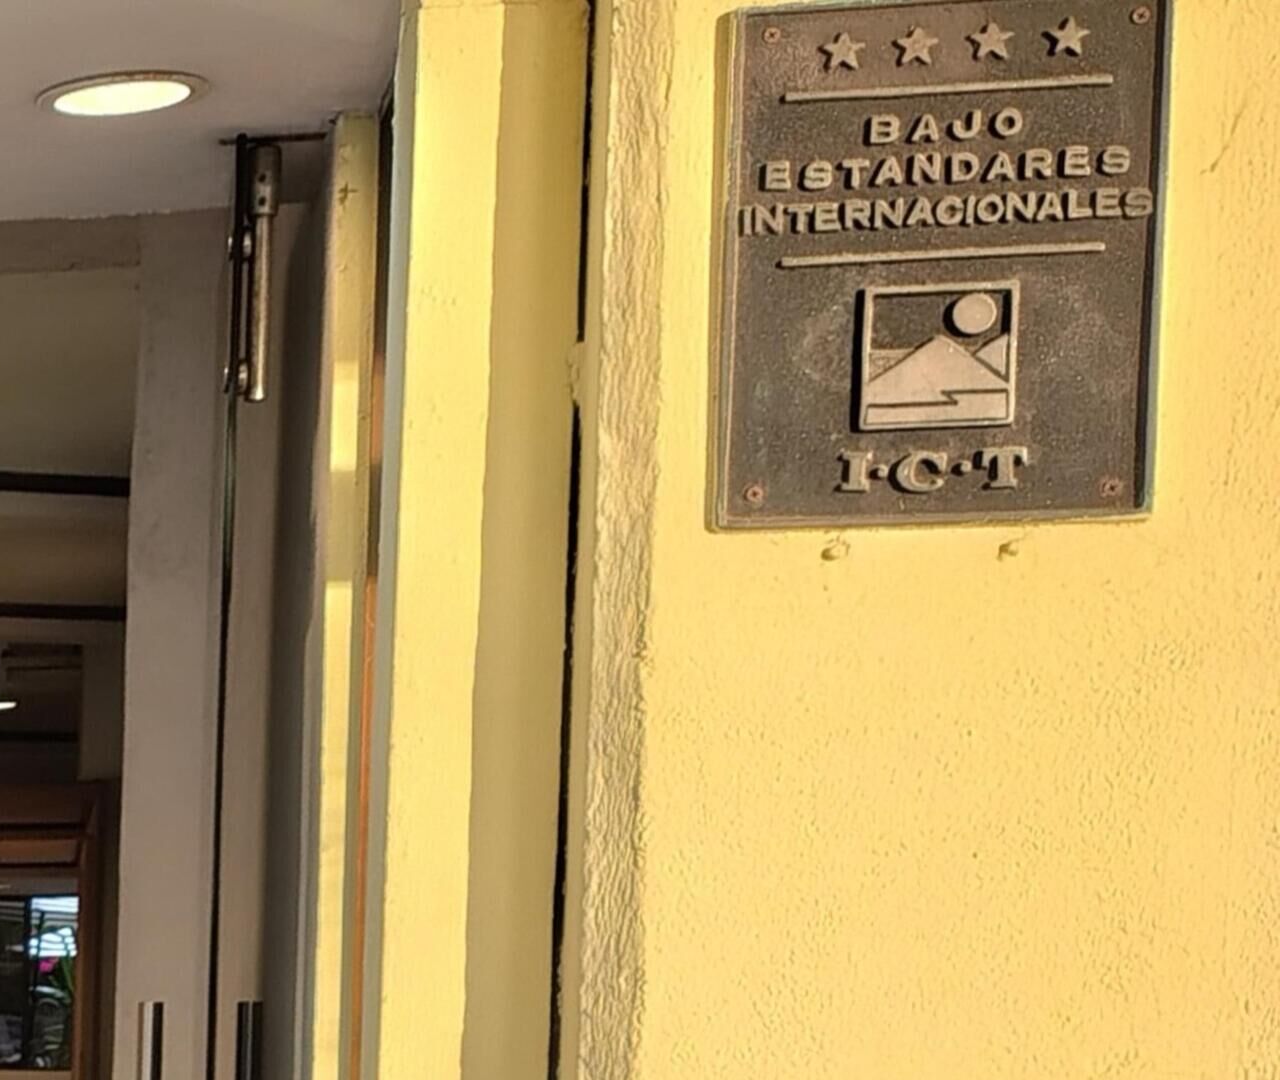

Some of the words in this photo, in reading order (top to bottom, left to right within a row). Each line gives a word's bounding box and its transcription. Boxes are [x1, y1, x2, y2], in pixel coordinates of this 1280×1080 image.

[867, 107, 1023, 145] BAJO
[761, 145, 1131, 191] ESTANDARES
[741, 187, 1154, 236] INTERNACIONALES
